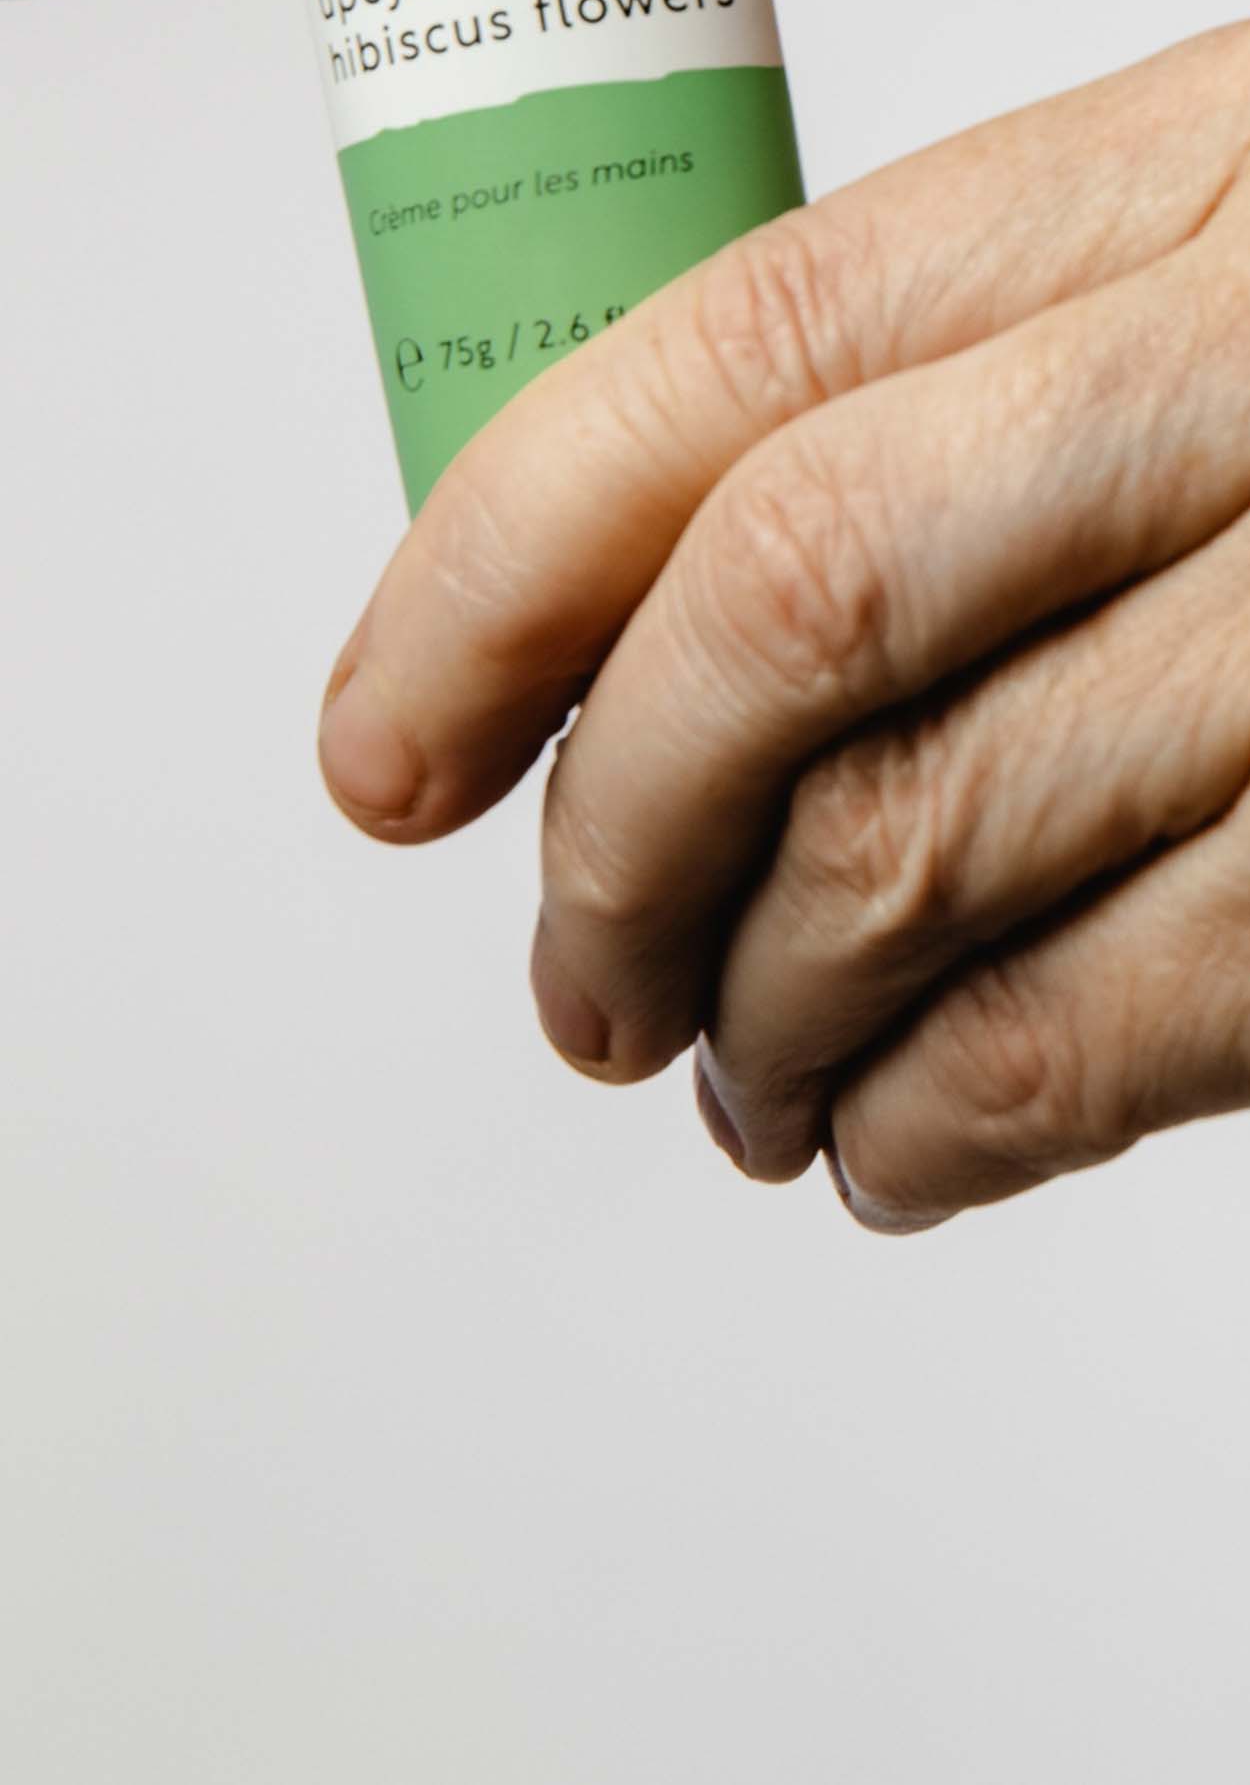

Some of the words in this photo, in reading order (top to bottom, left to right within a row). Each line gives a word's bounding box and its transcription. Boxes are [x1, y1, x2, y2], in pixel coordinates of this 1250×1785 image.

[328, 9, 513, 85] hibiscus
[451, 177, 525, 218] pour
[534, 169, 580, 198] les
[591, 150, 696, 186] mains
[438, 335, 497, 371] 75g
[533, 313, 591, 351] 2.6
